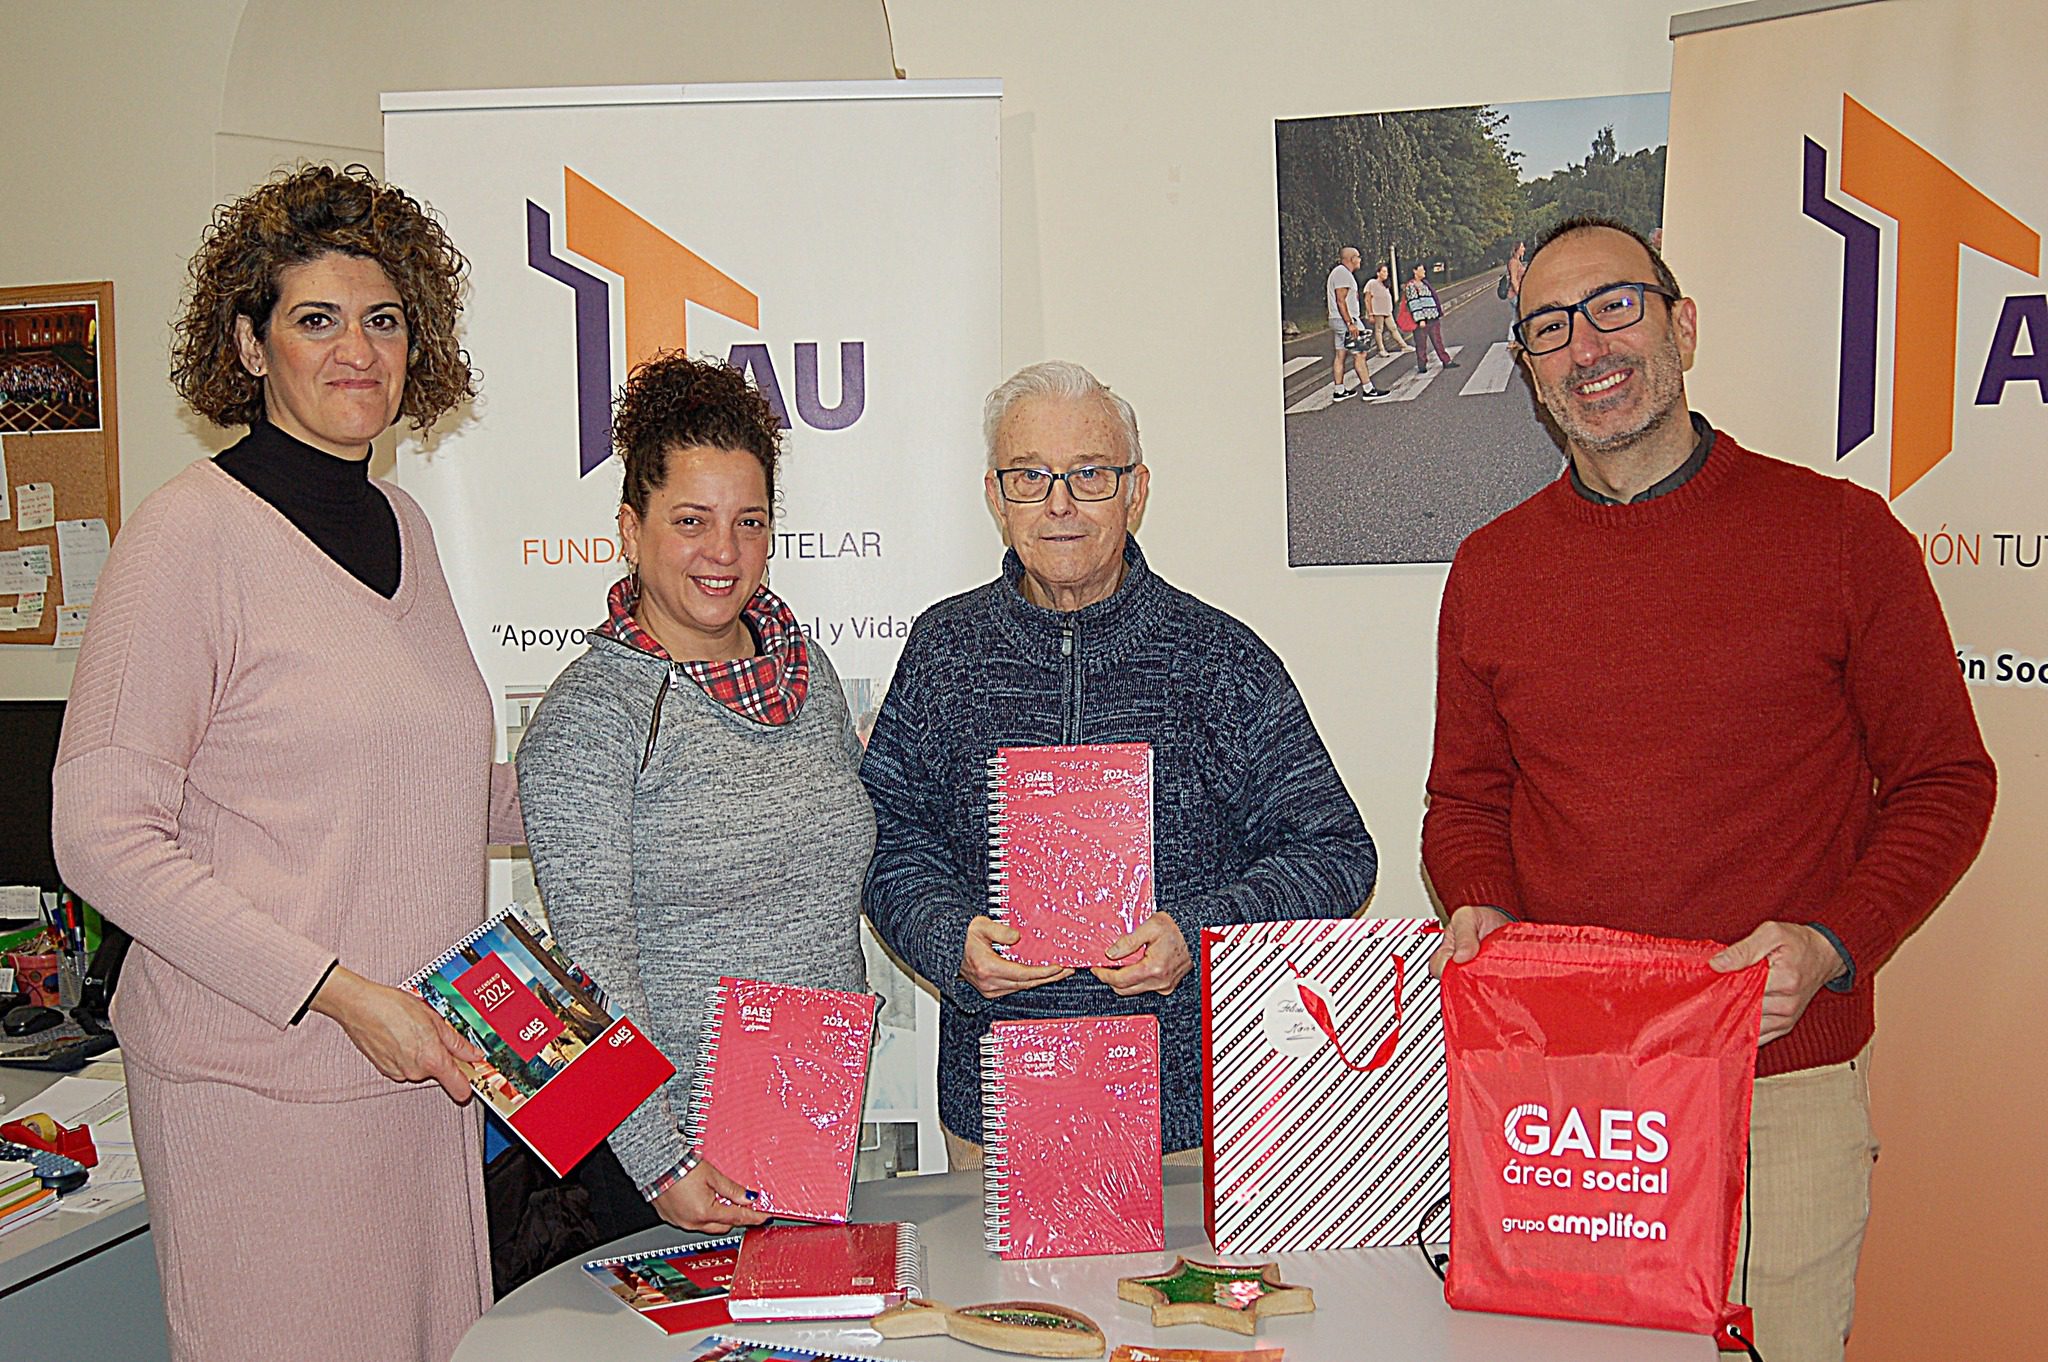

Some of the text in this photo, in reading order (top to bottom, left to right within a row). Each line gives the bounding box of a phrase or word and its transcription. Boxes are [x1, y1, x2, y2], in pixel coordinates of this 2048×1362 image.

[1993, 534, 2048, 568] TU
[829, 623, 844, 646] y
[1102, 768, 1130, 781] 2024
[478, 978, 512, 1009] 2024
[519, 1017, 545, 1041] GAES
[822, 1014, 851, 1028] 2024
[608, 1025, 632, 1048] GAES
[1023, 1045, 1137, 1063] GAES 2024
[1503, 1103, 1669, 1163] GAES
[1503, 1159, 1668, 1194] área social
[1502, 1212, 1667, 1242] grupo amplifon
